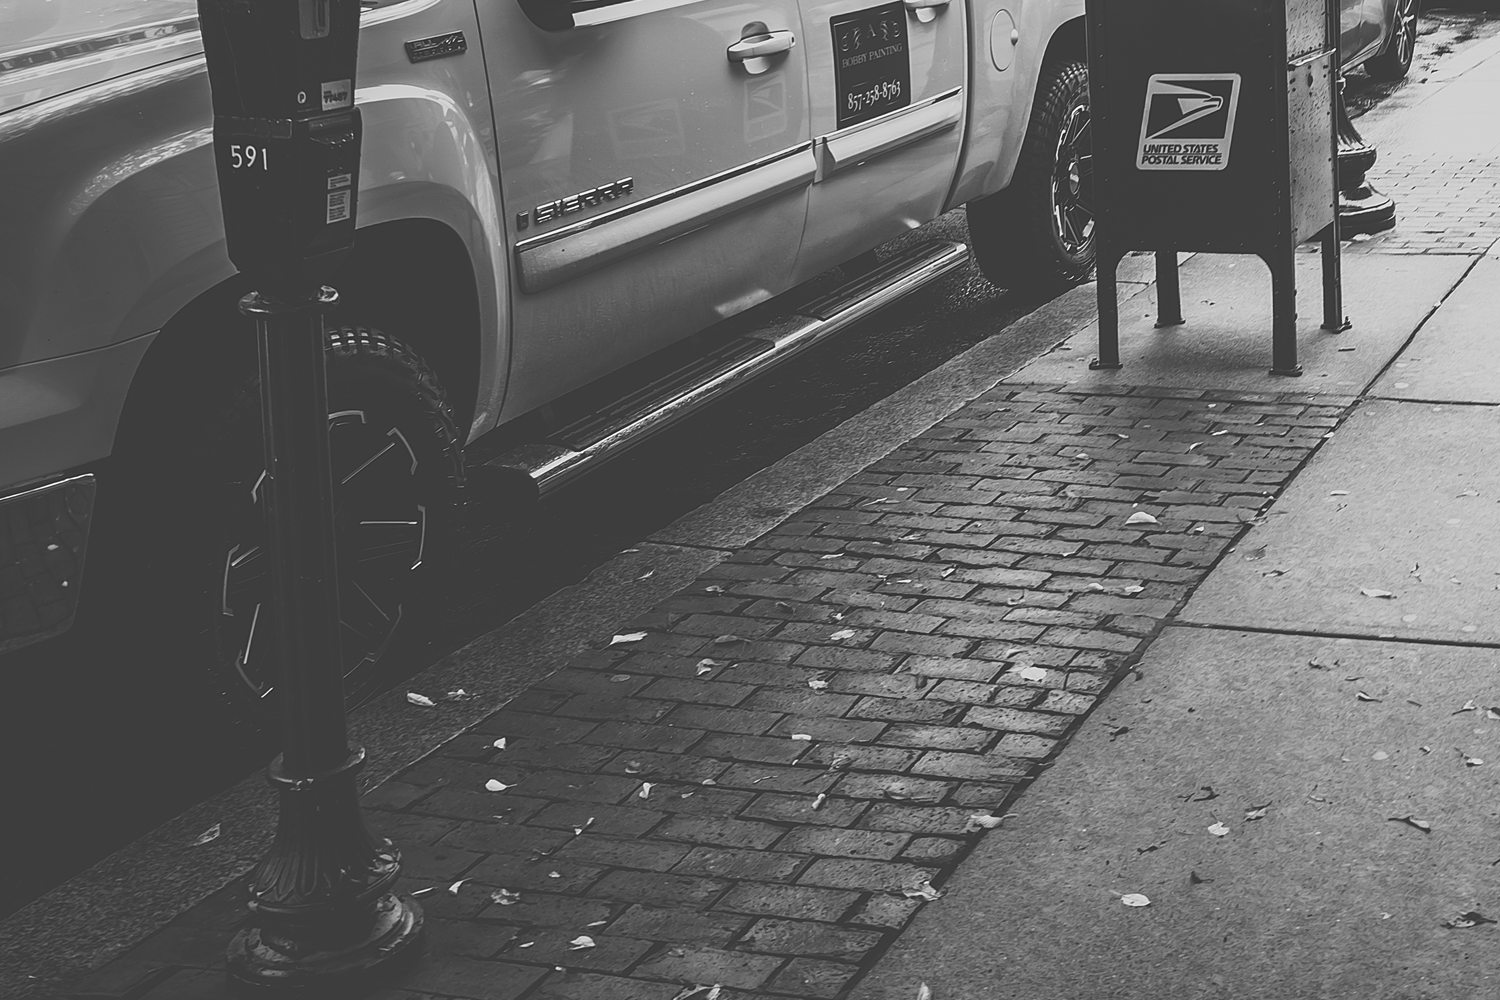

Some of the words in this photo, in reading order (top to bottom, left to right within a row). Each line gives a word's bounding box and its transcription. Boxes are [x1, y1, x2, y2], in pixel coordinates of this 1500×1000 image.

[842, 53, 868, 69] BOBBY
[869, 43, 903, 61] PAINTING
[847, 79, 901, 112] 857-258-8763
[231, 144, 268, 171] 591
[1141, 155, 1179, 165] POSTAL
[1180, 155, 1222, 165] SERVICE
[1143, 144, 1182, 153] UNITED
[1182, 144, 1219, 153] STATES
